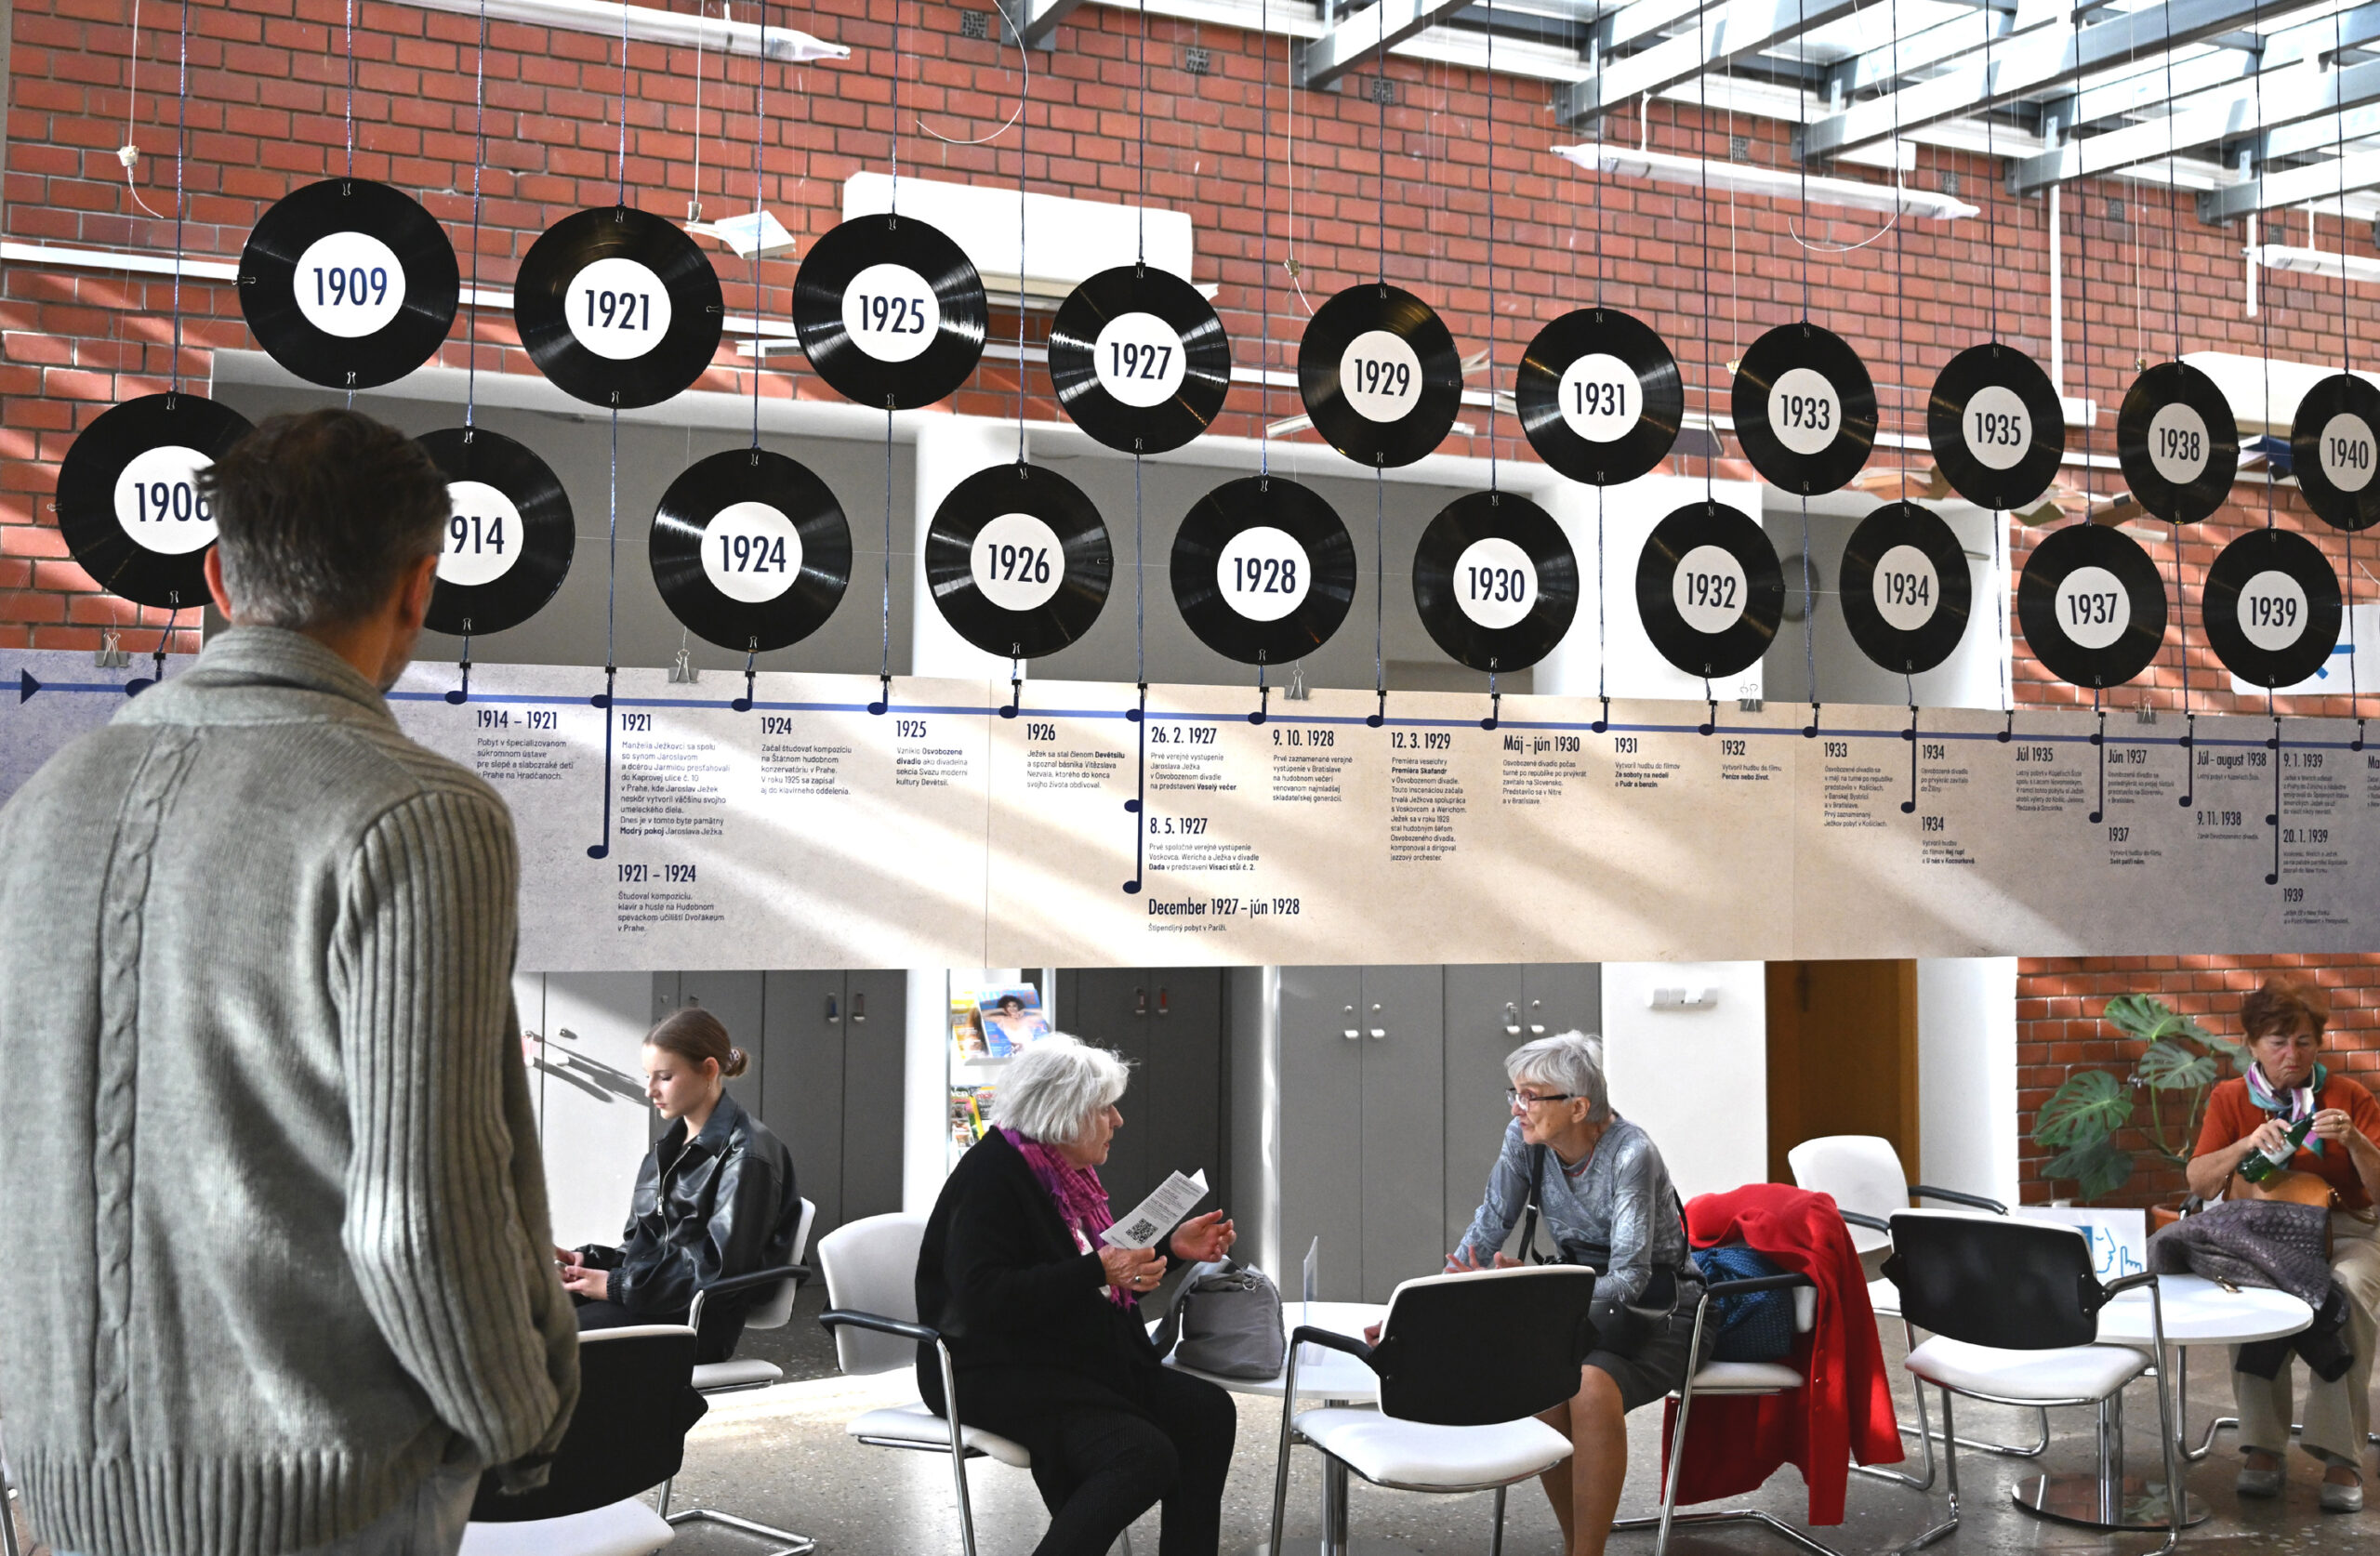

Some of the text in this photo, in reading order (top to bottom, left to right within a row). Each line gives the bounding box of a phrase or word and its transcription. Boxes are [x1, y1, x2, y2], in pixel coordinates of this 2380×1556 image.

[313, 268, 387, 305] 1909
[586, 290, 649, 330] 1921
[860, 296, 924, 334] 1925
[1111, 342, 1171, 379] 1927
[1355, 359, 1409, 396] 1929
[1574, 382, 1624, 415] 1931
[1781, 395, 1830, 430] 1933
[1976, 413, 2020, 446] 1935
[2160, 428, 2200, 461] 1938
[2330, 438, 2368, 469] 1940
[441, 516, 504, 554] 914
[721, 535, 786, 573] 1924
[989, 545, 1050, 583] 1926
[1235, 558, 1295, 593] 1928
[1469, 567, 1525, 602] 1930
[1687, 573, 1736, 609] 1932
[1885, 573, 1929, 606] 1934
[2068, 593, 2117, 625] 1937
[2251, 597, 2296, 626] 1939
[477, 710, 508, 728] 1914
[527, 711, 556, 729] 1921
[622, 714, 651, 731] 1921
[761, 718, 791, 734] 1924
[896, 720, 926, 737] 1925
[1027, 724, 1055, 741] 1926
[1152, 727, 1217, 744] 26. 2. 1927
[1274, 730, 1333, 746] 9. 10. 1928
[1392, 732, 1450, 749] 12. 3. 1929
[1504, 735, 1523, 754] Máj
[1534, 736, 1550, 755] jún
[1555, 736, 1580, 752] 1930
[1615, 738, 1637, 753] 1931
[1722, 740, 1745, 755] 1932
[1825, 743, 1847, 758] 1933
[1923, 745, 1944, 759] 1934
[2016, 746, 2053, 761] Júl 1935
[2109, 749, 2147, 764] Jún 1937
[2197, 751, 2209, 765] Júl
[2217, 754, 2243, 769] august
[2247, 753, 2267, 766] 1938
[2304, 754, 2322, 768] 1939
[1150, 818, 1208, 834] 8. 5. 1927
[1922, 816, 1943, 831] 1934
[2222, 811, 2241, 825] 1938
[2109, 827, 2129, 841] 1937
[2309, 829, 2328, 843] 1939
[618, 864, 647, 882] 1921
[665, 864, 695, 882] 1924
[2284, 889, 2303, 902] 1939
[1149, 897, 1207, 915] December
[1211, 899, 1238, 915] 1927
[1250, 899, 1267, 918] jún
[1273, 899, 1299, 915] 1928
